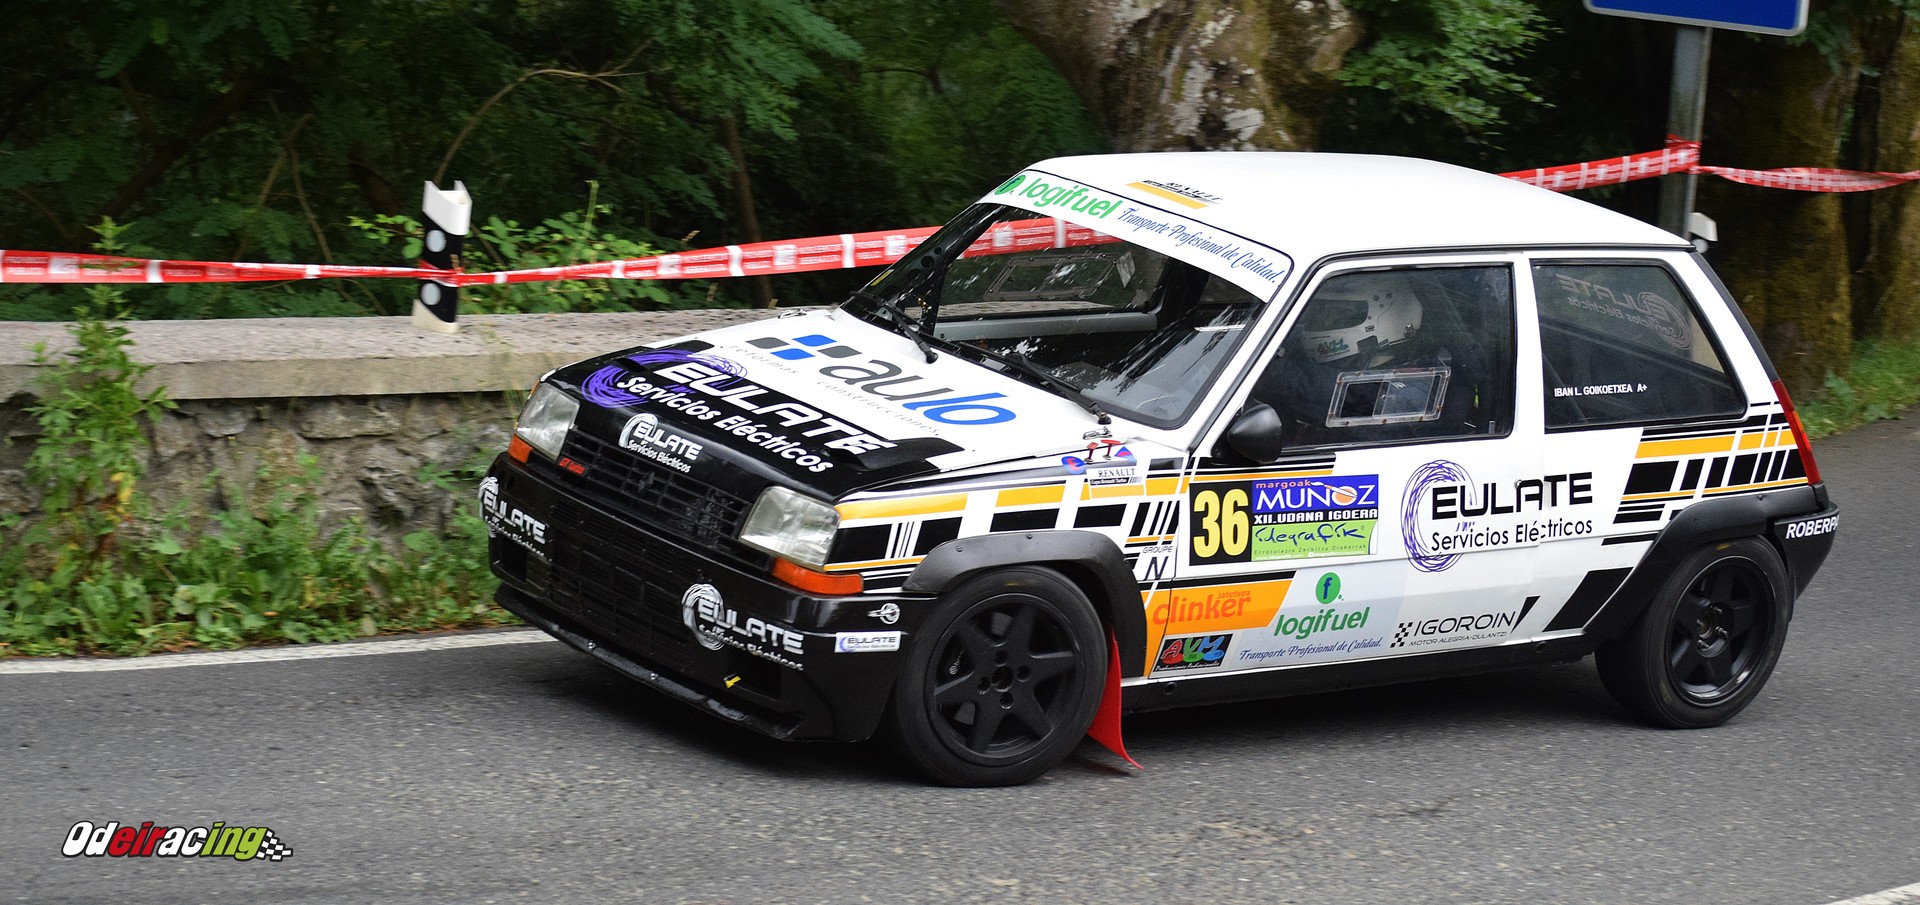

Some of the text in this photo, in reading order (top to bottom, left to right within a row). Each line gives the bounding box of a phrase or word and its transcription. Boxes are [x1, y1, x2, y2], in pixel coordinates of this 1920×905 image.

[1021, 178, 1123, 219] logifuel
[1117, 208, 1171, 237] Transporte
[1168, 224, 1227, 255] Profesional
[1220, 244, 1240, 262] de
[1230, 252, 1285, 284] Calidad.
[728, 345, 799, 375] reformas
[818, 359, 1017, 426] aulo
[1554, 386, 1574, 397] IBAN
[1583, 384, 1633, 396] GOIKOETXEA
[1637, 383, 1648, 393] A+
[653, 361, 899, 456] EULATE
[616, 376, 835, 473] Servicios Eléctricos
[632, 421, 704, 461] EULATE
[1255, 480, 1311, 490] margoak
[1432, 471, 1593, 521] EULATE
[483, 490, 546, 545] EULATE
[1193, 488, 1250, 558] 36
[1253, 508, 1378, 525] XII.UDANA IGOERA
[1143, 546, 1173, 554] GROUPE
[1431, 527, 1509, 552] Servicios
[1143, 556, 1169, 582] N
[1152, 595, 1252, 626] clinker
[1273, 606, 1371, 640] logifuel
[1413, 610, 1517, 637] IGOROIN
[697, 597, 805, 655] EULATE
[847, 636, 897, 645] EULATE
[1160, 636, 1225, 660] AVM
[1240, 637, 1383, 663] Transporte Profesional de Calidad.
[1409, 638, 1438, 646] MOTOR
